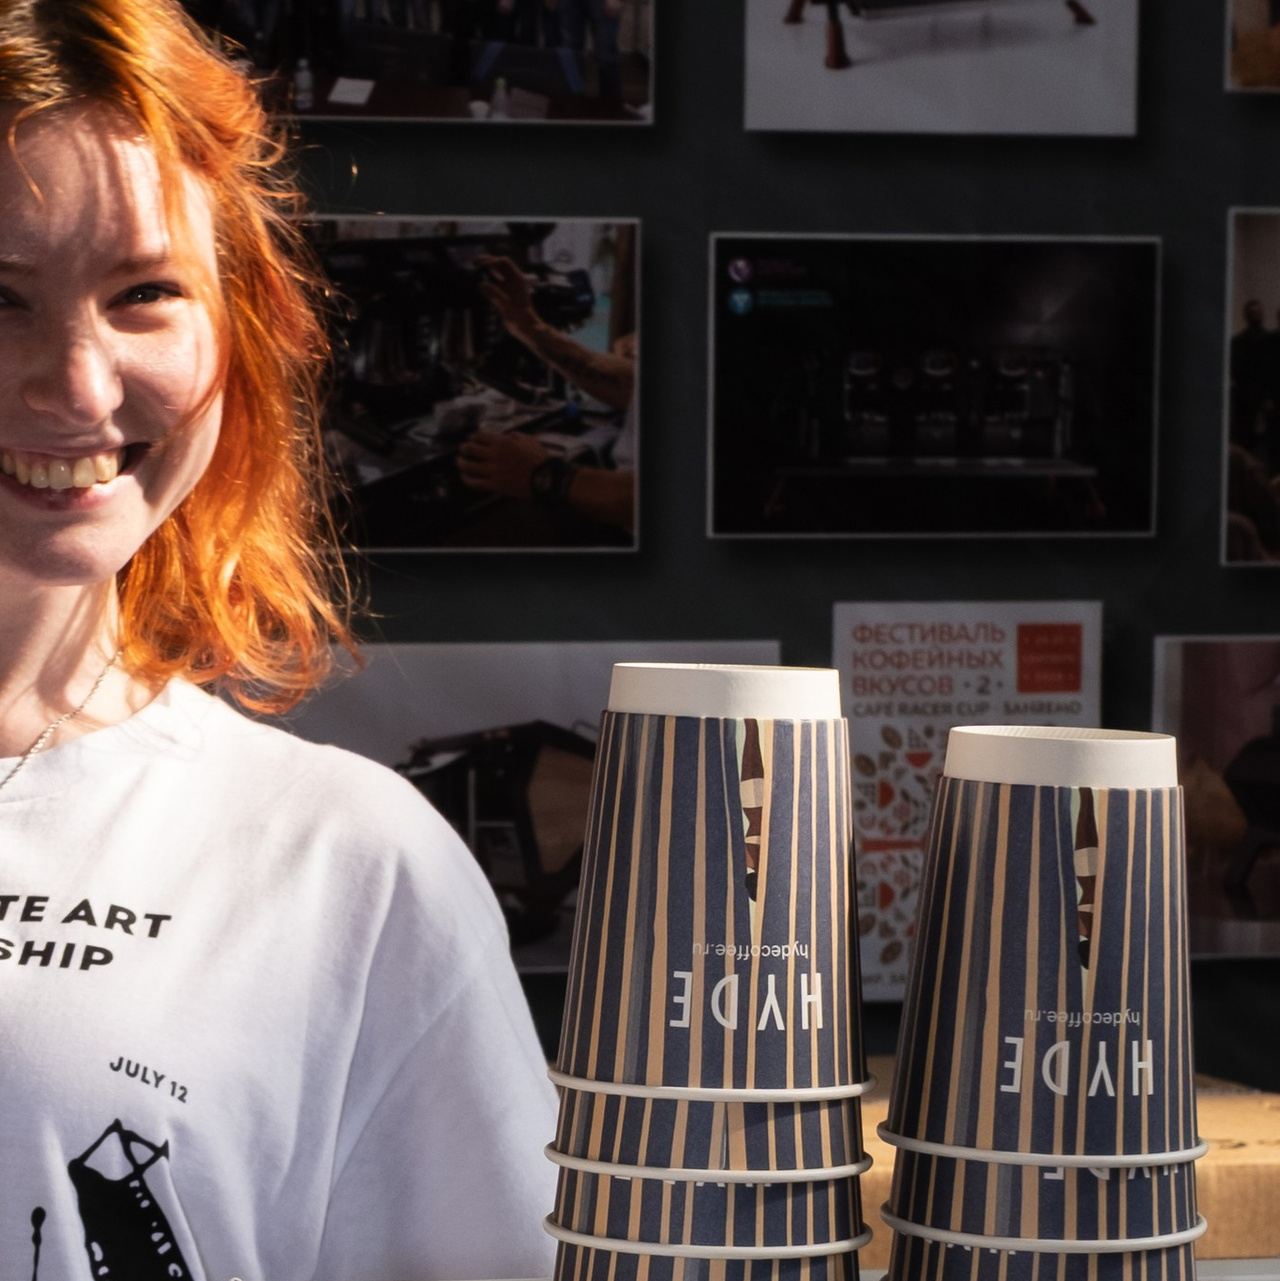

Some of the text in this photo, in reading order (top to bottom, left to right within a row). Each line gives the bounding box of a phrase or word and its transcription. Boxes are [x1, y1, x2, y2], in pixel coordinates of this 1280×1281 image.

[851, 622, 1006, 645] ФЕСТИВАЛЬ
[851, 645, 1004, 670] КОФЕЙНЫХ
[851, 675, 954, 696] ВКУСОВ
[61, 898, 172, 939] ART
[693, 941, 809, 961] hydecoffee.ru
[670, 971, 824, 1030] HYDE
[1024, 1008, 1140, 1027] hydecoffee.ru
[1000, 1036, 1154, 1097] HYDE
[110, 1056, 188, 1104] JULY 12
